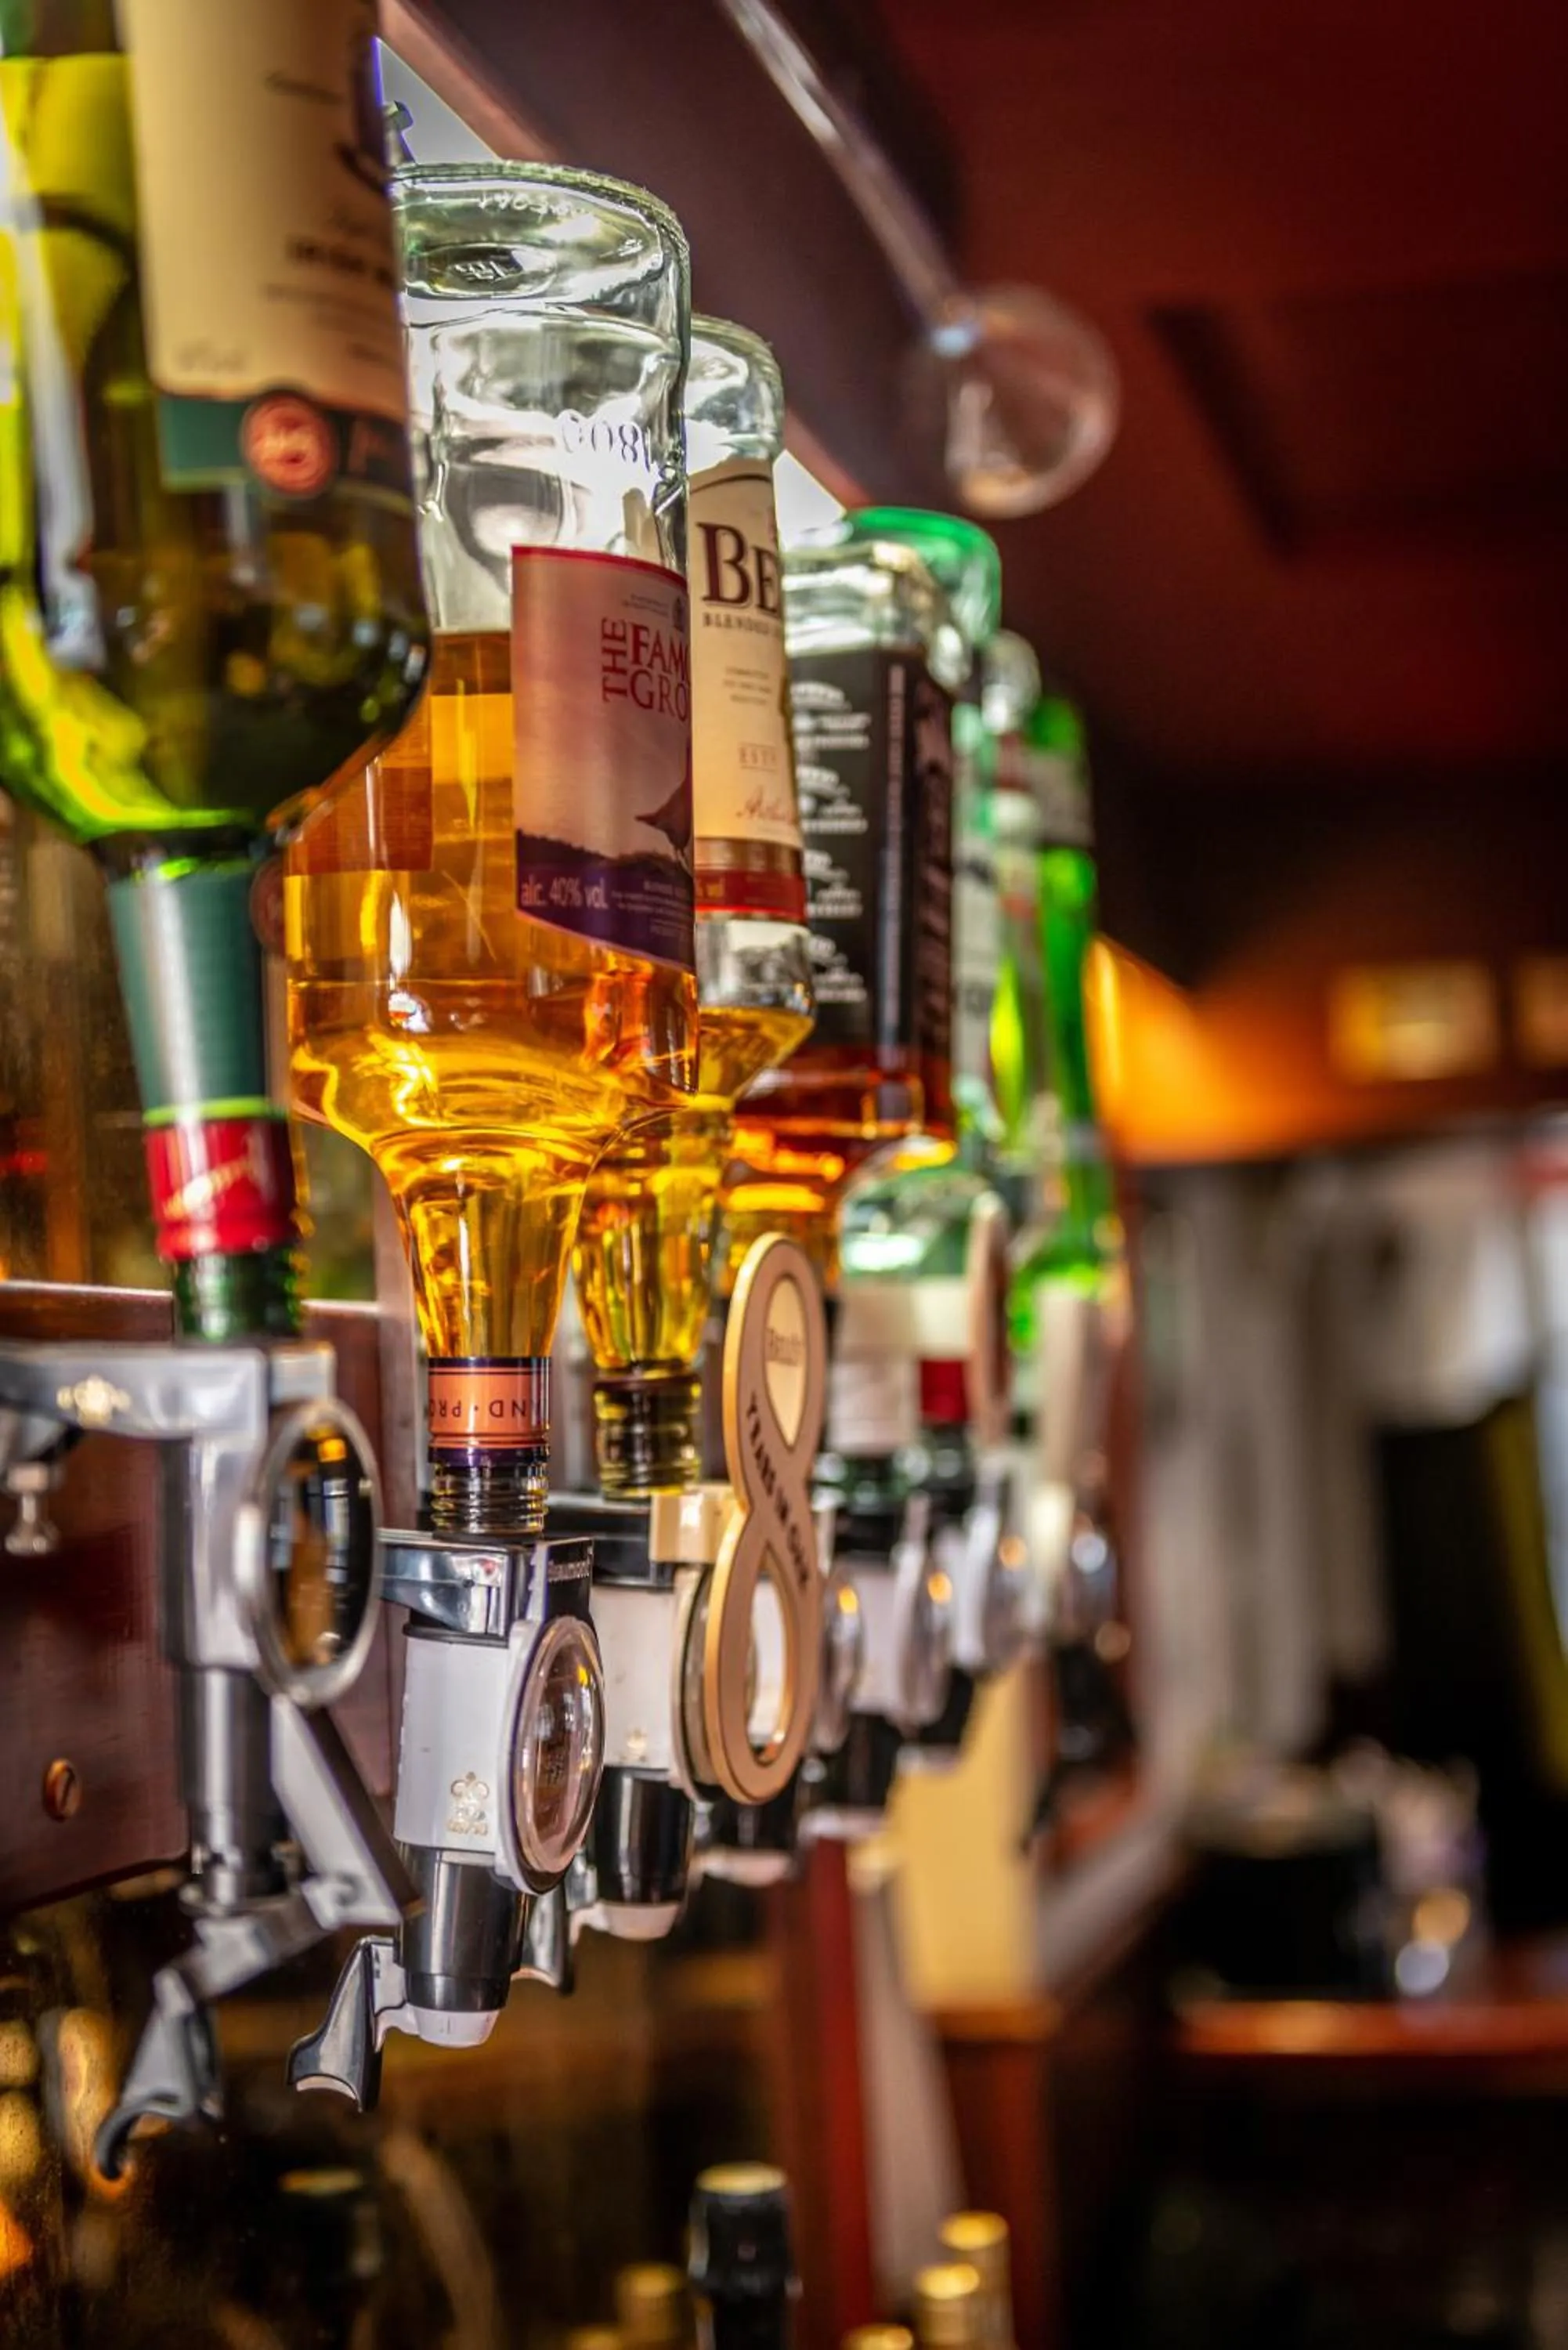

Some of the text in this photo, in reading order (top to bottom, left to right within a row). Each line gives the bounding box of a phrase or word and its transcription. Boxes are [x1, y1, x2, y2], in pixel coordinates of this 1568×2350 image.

[602, 617, 627, 702] THE
[630, 622, 690, 682] FAM
[522, 873, 546, 906] alc.
[550, 877, 582, 908] 40%
[489, 1399, 536, 1418] ND
